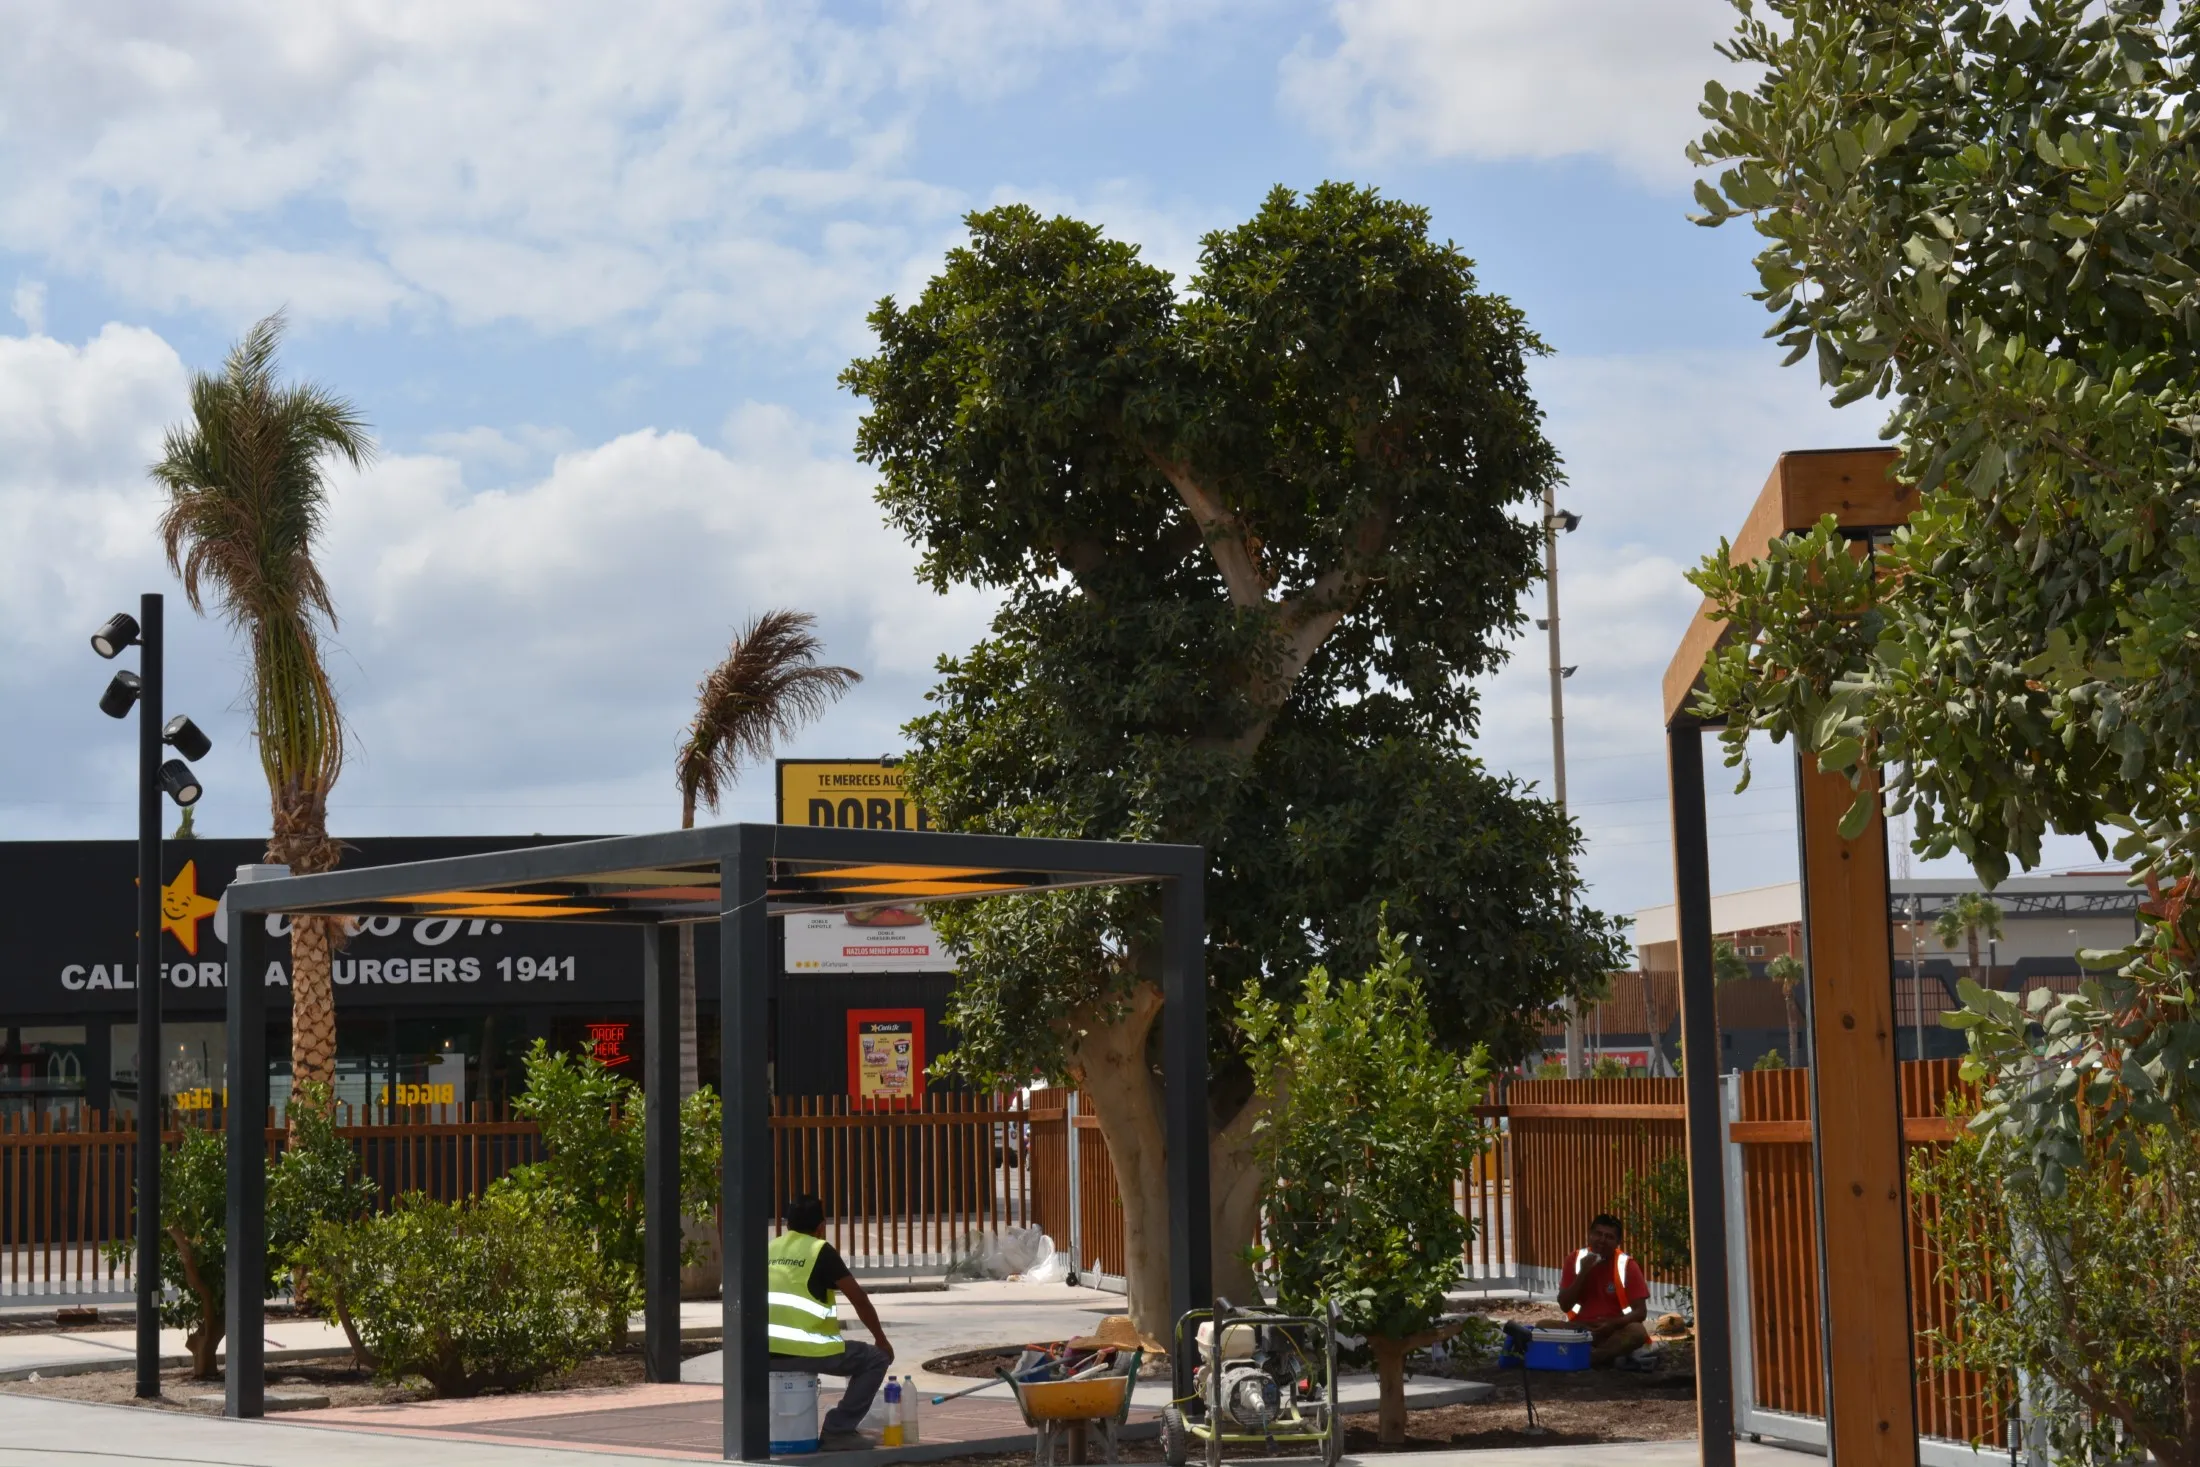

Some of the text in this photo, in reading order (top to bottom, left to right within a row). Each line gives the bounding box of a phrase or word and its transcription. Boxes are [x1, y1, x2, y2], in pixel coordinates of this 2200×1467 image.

[819, 774, 830, 786] TE
[833, 774, 880, 786] MERECES
[61, 956, 575, 990] CALORA URGERS 1941
[591, 1028, 624, 1041] ORDER
[595, 1042, 620, 1056] HERE
